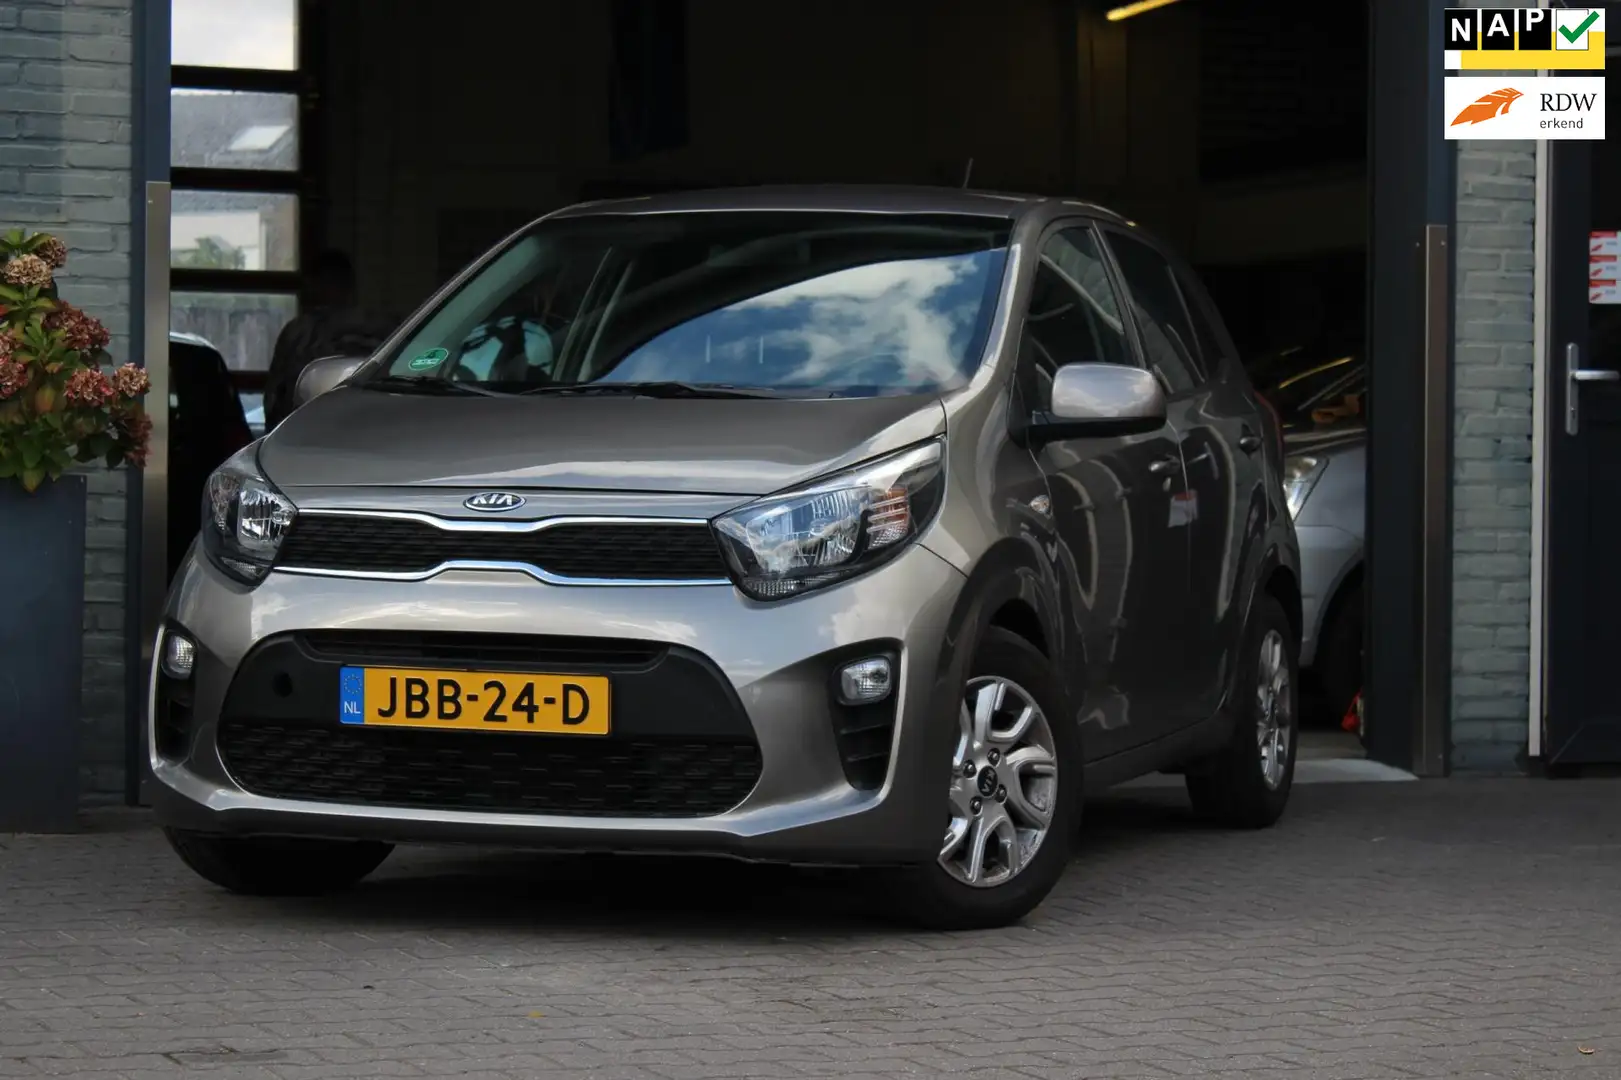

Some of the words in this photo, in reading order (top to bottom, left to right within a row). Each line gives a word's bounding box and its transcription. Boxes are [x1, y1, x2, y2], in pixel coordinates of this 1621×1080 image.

[472, 493, 513, 506] KIA
[344, 701, 361, 714] NL
[377, 676, 590, 725] JBB-24-D
